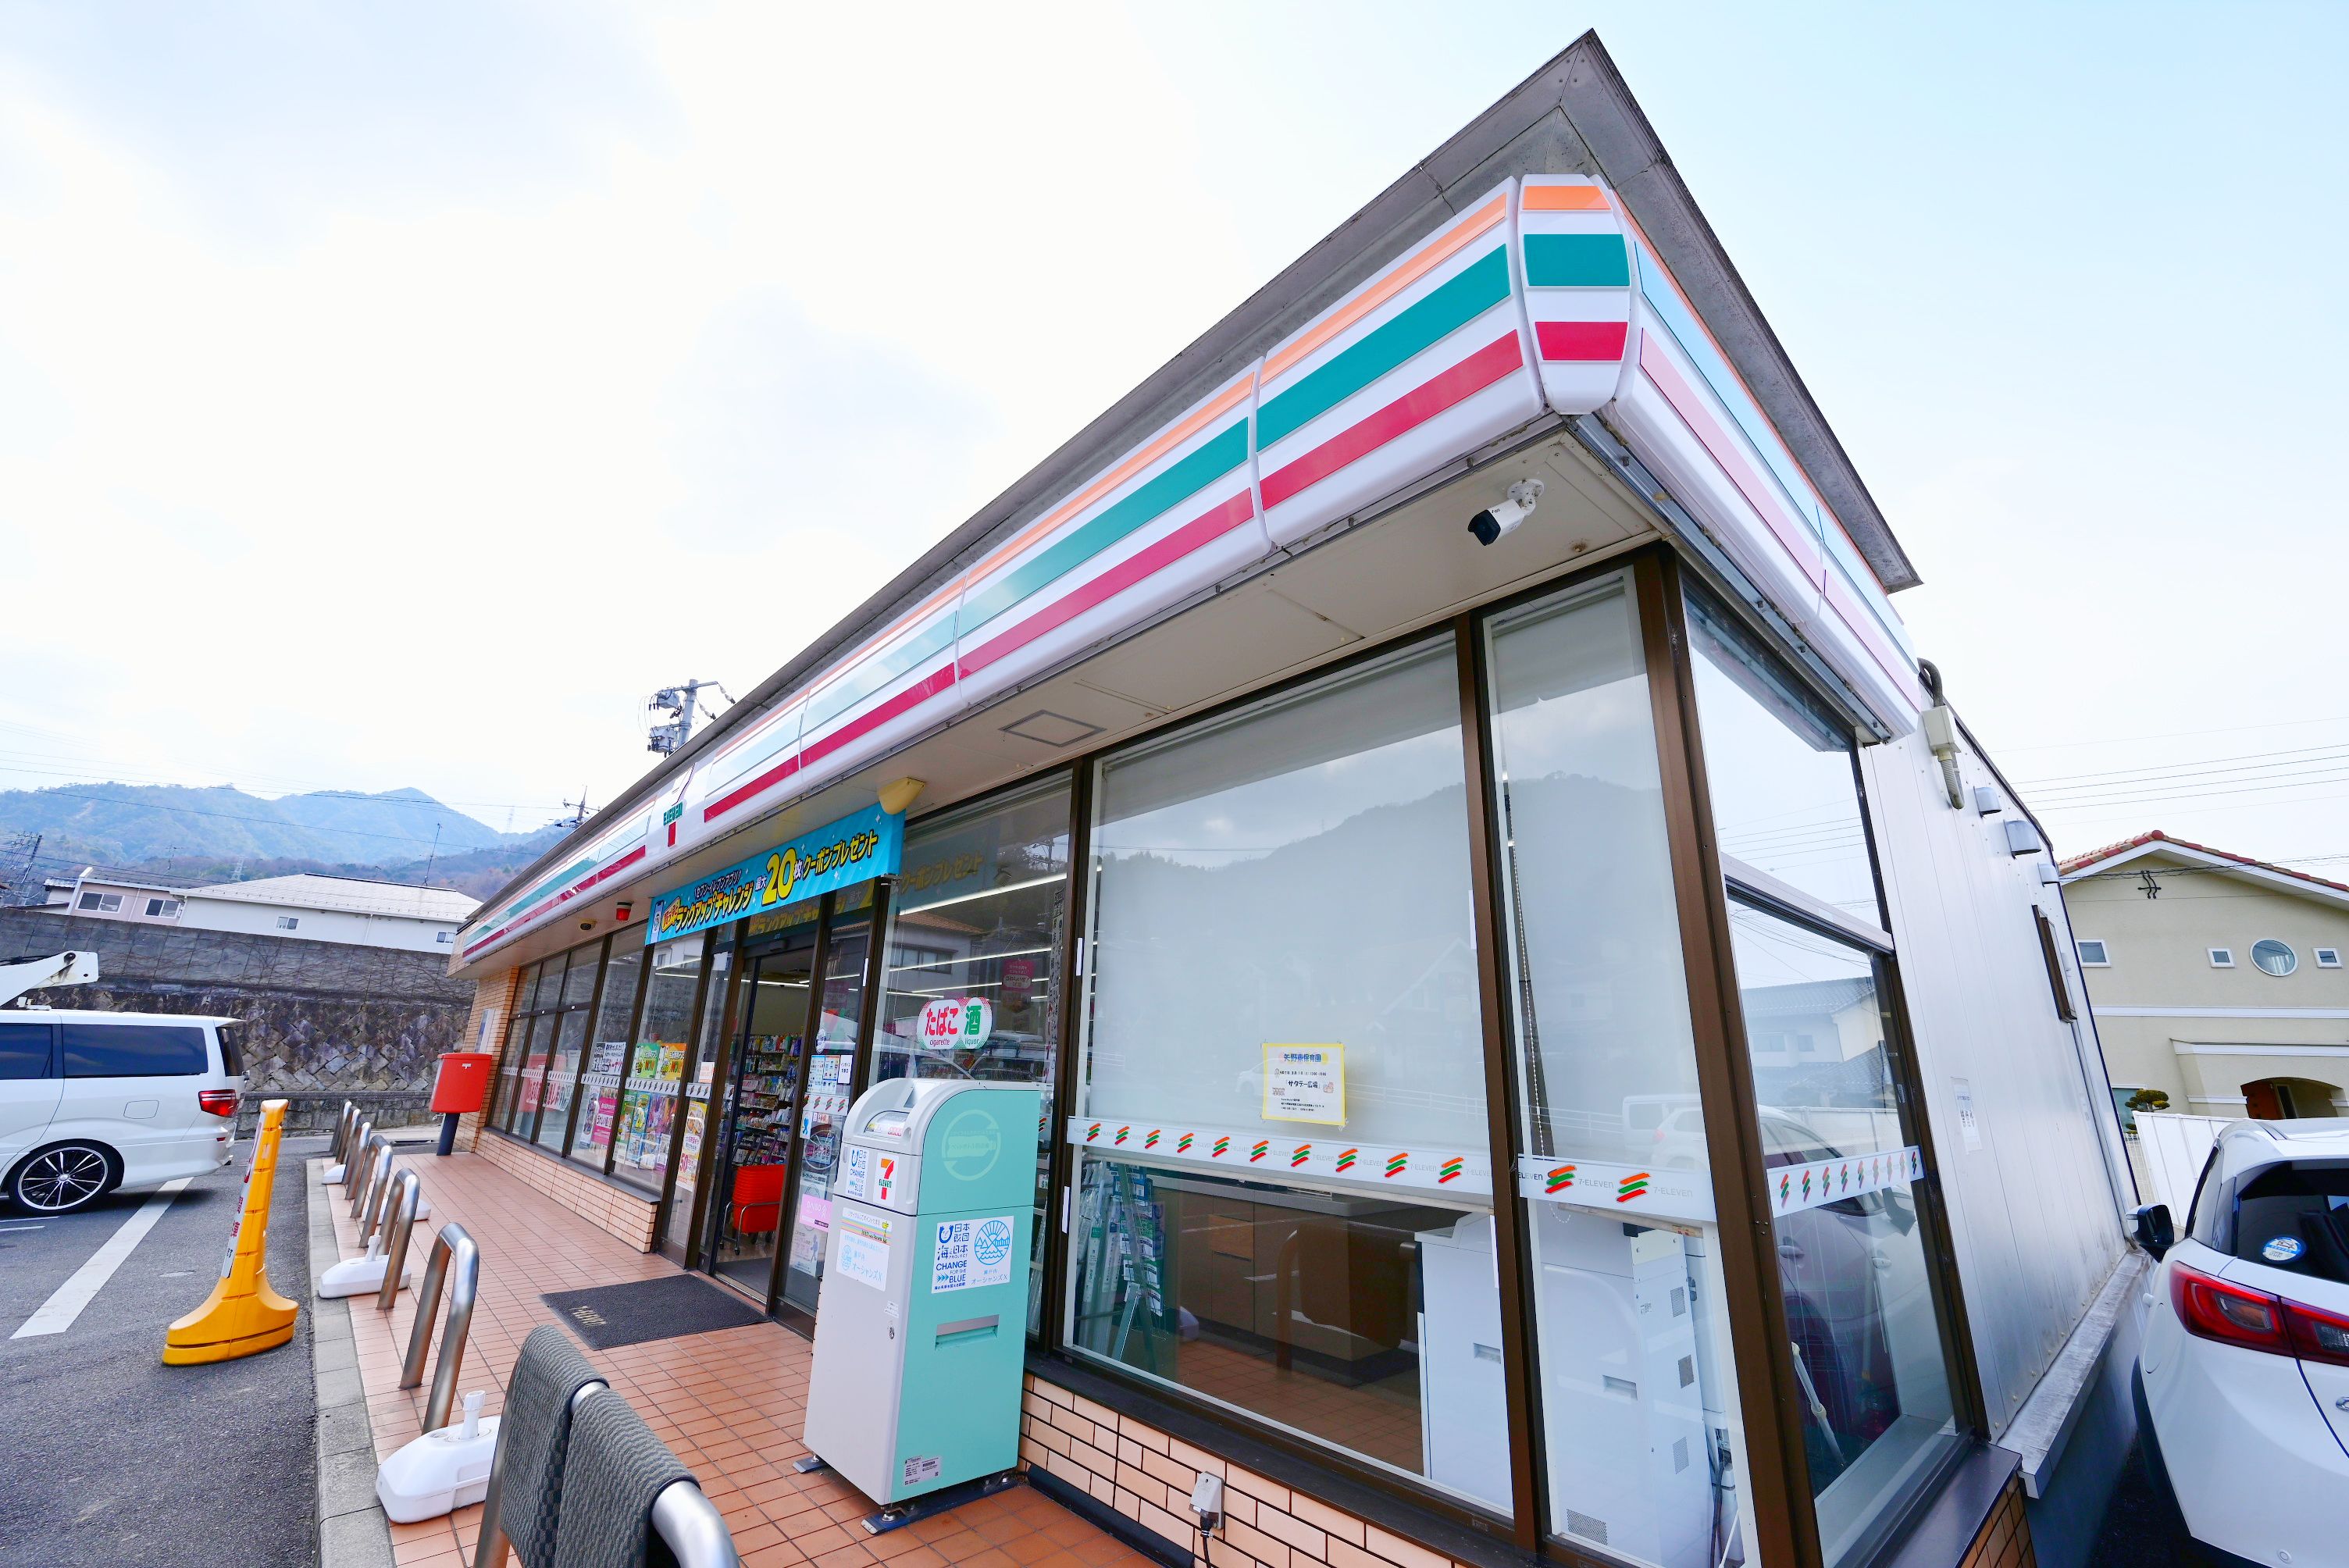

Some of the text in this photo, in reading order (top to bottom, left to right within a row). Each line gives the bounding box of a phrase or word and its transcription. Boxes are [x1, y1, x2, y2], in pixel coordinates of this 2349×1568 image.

[675, 881, 754, 933] ランクアップチャレンジ
[925, 1005, 982, 1036] たばこ 酒
[929, 1038, 980, 1047] cigarette liquor
[850, 1168, 865, 1178] CHANGE
[1466, 1168, 1492, 1177] 7-ELEVE
[954, 1223, 970, 1233] 日本
[954, 1232, 970, 1243] 財団
[936, 1260, 968, 1271] CHANGE
[949, 1274, 967, 1284] BLUE
